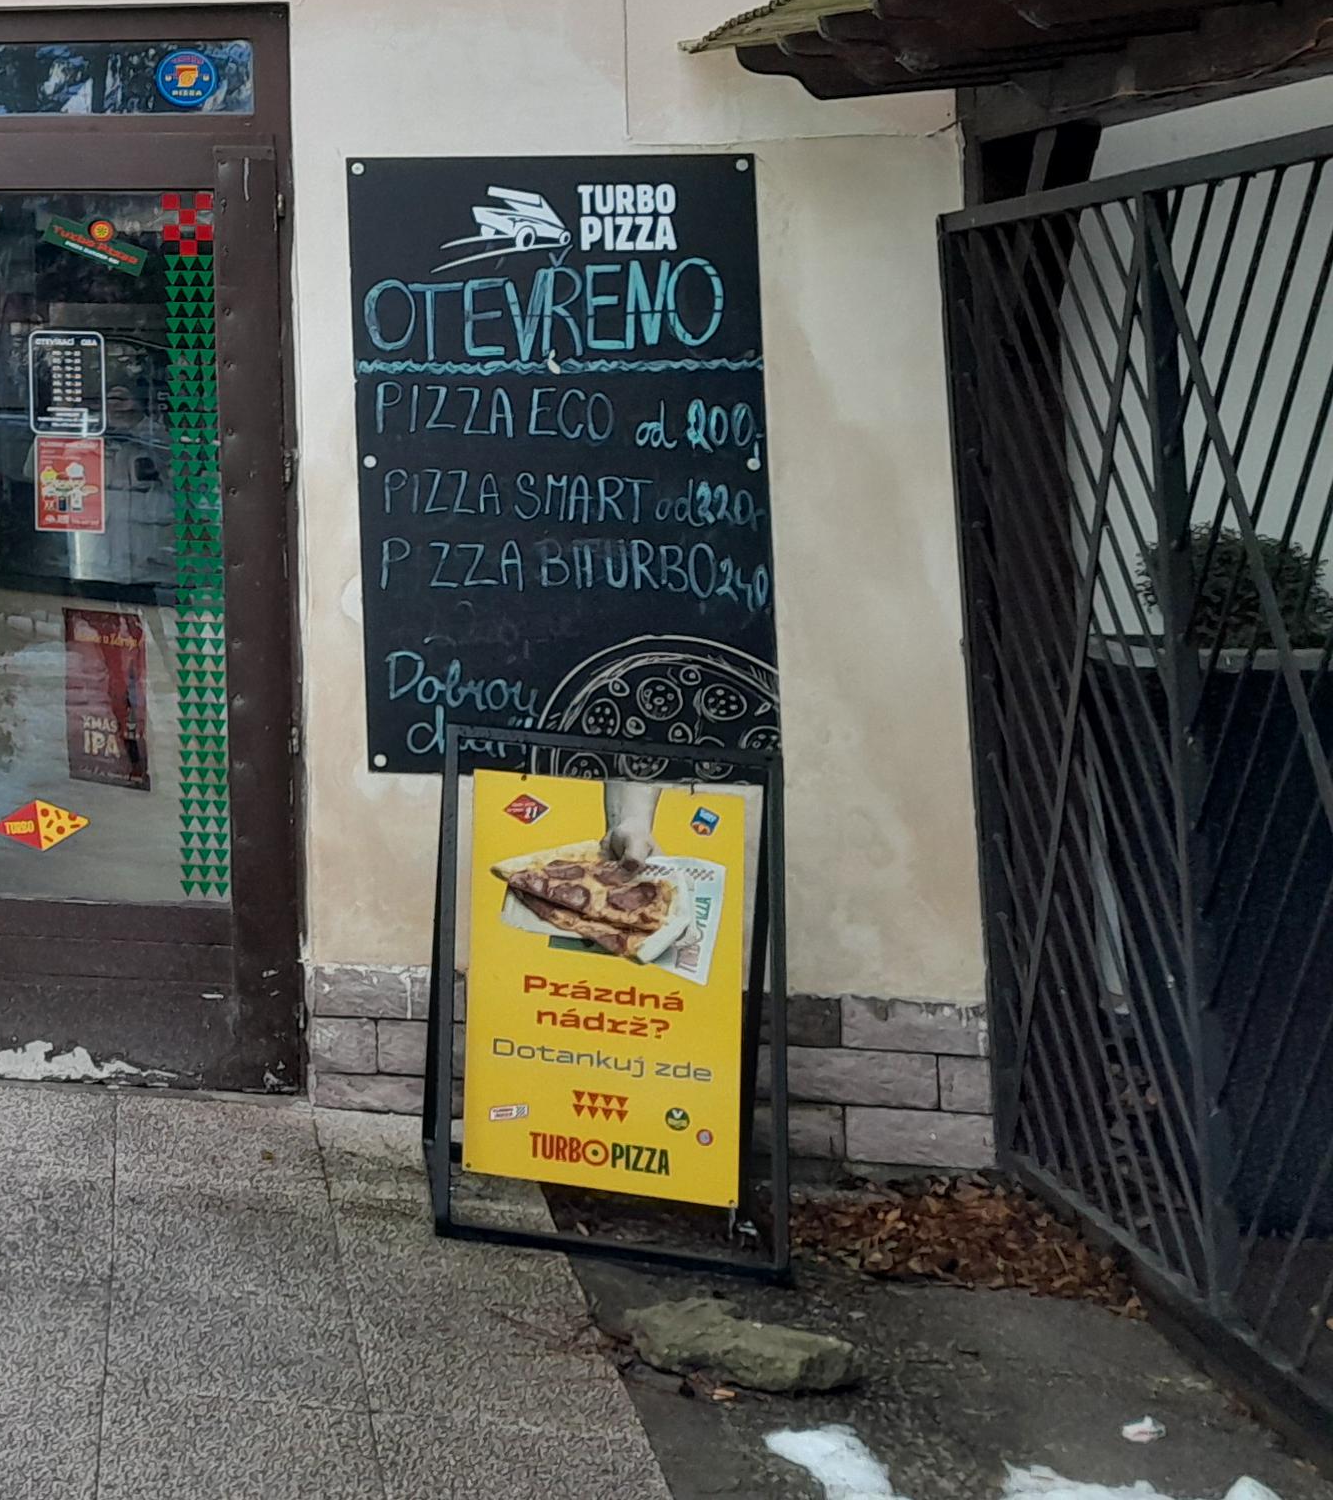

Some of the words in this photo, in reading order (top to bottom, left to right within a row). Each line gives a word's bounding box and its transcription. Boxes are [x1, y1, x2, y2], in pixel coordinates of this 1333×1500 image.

[577, 184, 677, 215] TURBO
[579, 216, 677, 251] PIZZA
[363, 250, 724, 361] OTEVŘENO
[376, 381, 514, 439] PIZZA
[528, 387, 614, 446] ECO
[635, 399, 677, 450] od
[384, 468, 502, 516] PIZZA
[513, 472, 654, 525] SMART
[380, 537, 524, 592] PZZA
[385, 650, 539, 717] Dobrou
[84, 729, 121, 758] IPA
[523, 974, 684, 1013] Prázdná
[536, 1008, 671, 1040] nádrž?
[492, 1037, 646, 1079] Dotankuj
[655, 1061, 713, 1083] zde
